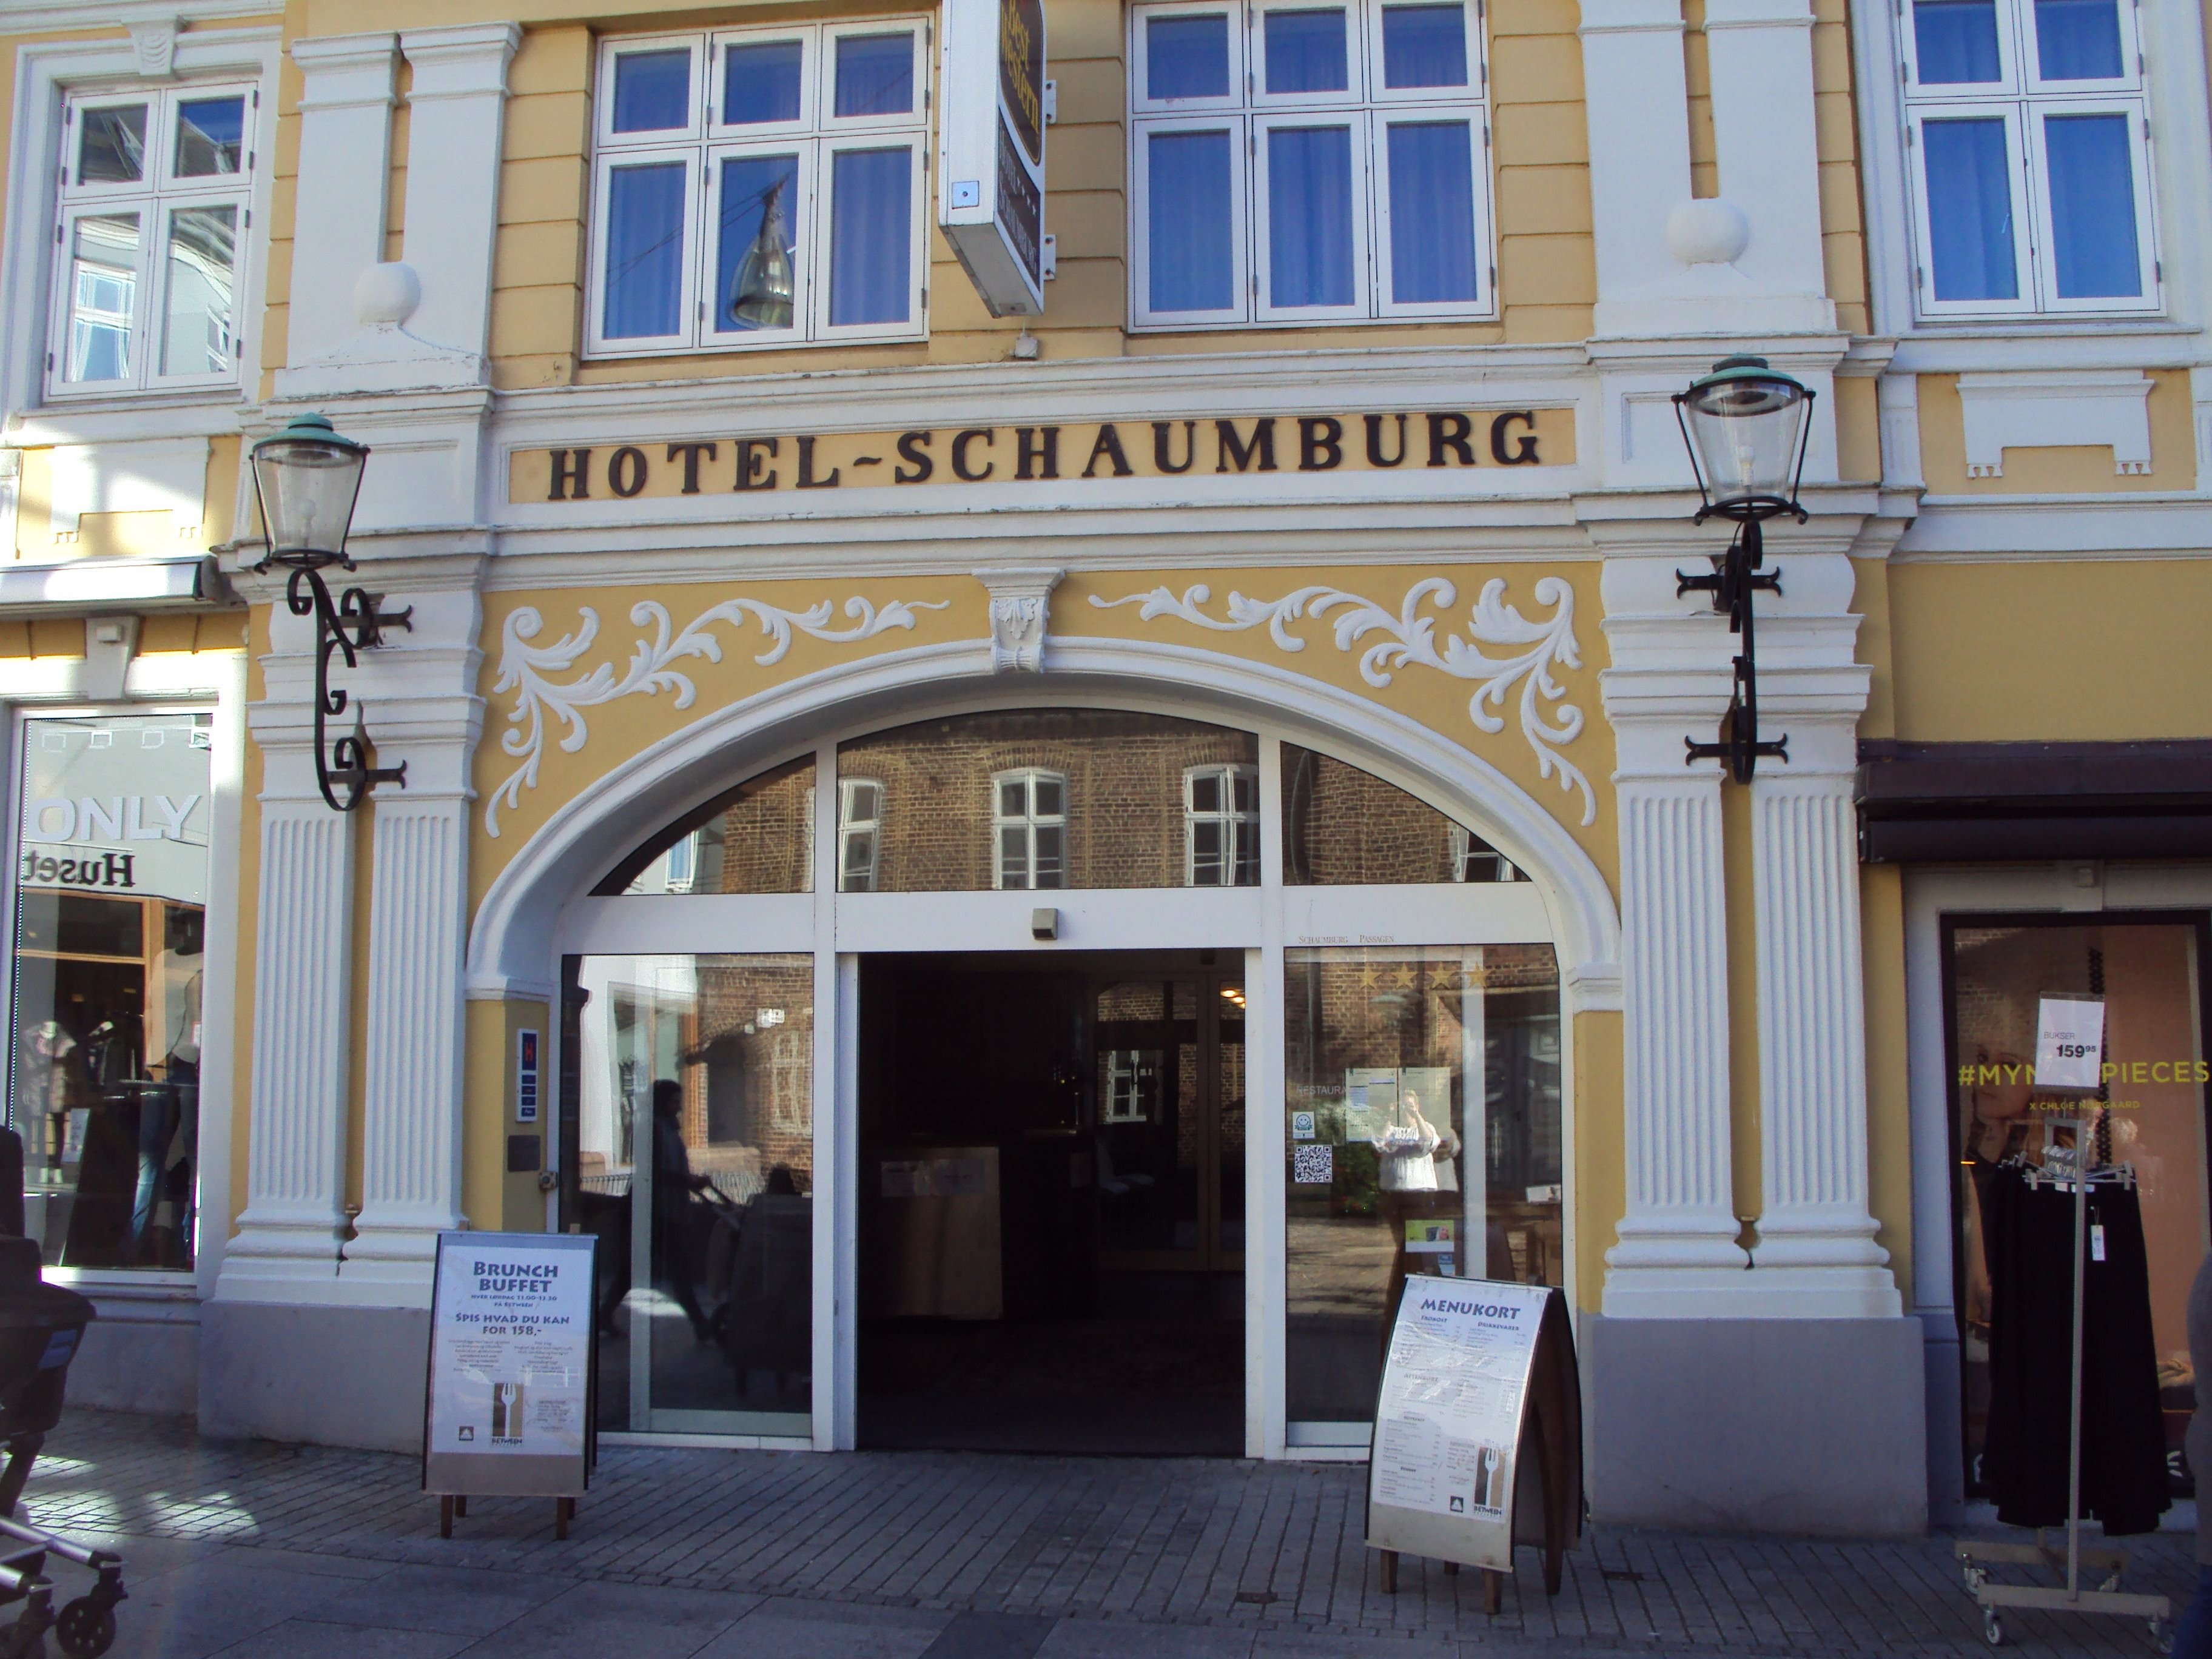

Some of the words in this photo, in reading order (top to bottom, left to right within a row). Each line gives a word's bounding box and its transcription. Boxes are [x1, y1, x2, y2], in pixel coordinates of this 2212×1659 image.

[29, 795, 201, 842] ONLY
[474, 1261, 558, 1278] BRUNCH
[479, 1278, 552, 1293] BUFFET
[1420, 1298, 1521, 1320] MENUKORT
[456, 1313, 480, 1322] SPIS
[483, 1315, 519, 1323] HVAD
[522, 1315, 540, 1324] DU
[543, 1316, 570, 1324] KAN
[512, 1326, 542, 1336] 158,-
[1473, 1505, 1502, 1515] BETWEEN
